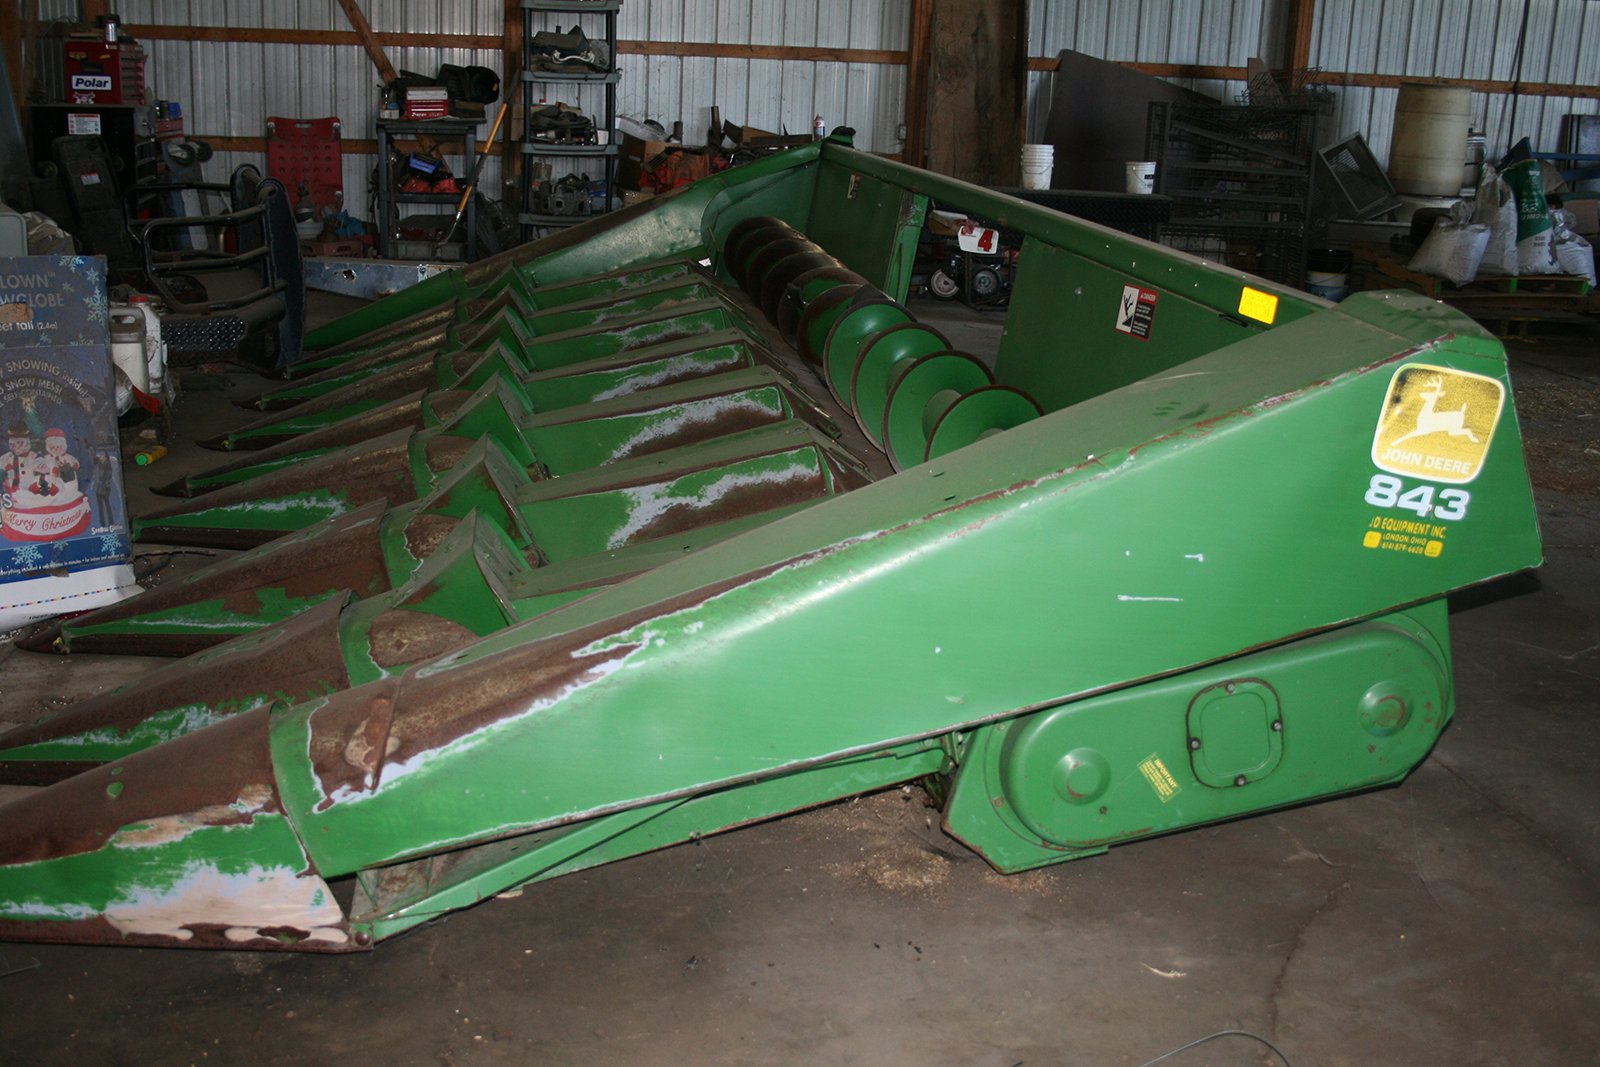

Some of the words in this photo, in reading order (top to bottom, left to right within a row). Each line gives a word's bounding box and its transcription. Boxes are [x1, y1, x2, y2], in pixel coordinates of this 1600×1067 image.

[75, 78, 108, 88] Polar
[978, 229, 993, 252] 4
[6, 360, 60, 376] SNOWING
[5, 378, 36, 391] SNOW
[1382, 448, 1421, 465] JOHN
[1424, 455, 1472, 475] DEERE
[1364, 474, 1470, 520] 843
[9, 513, 36, 531] Merry
[42, 510, 82, 531] Christmas
[1369, 515, 1381, 528] JD
[1381, 517, 1431, 535] EQUIPMENT
[1410, 536, 1427, 545] OHIO
